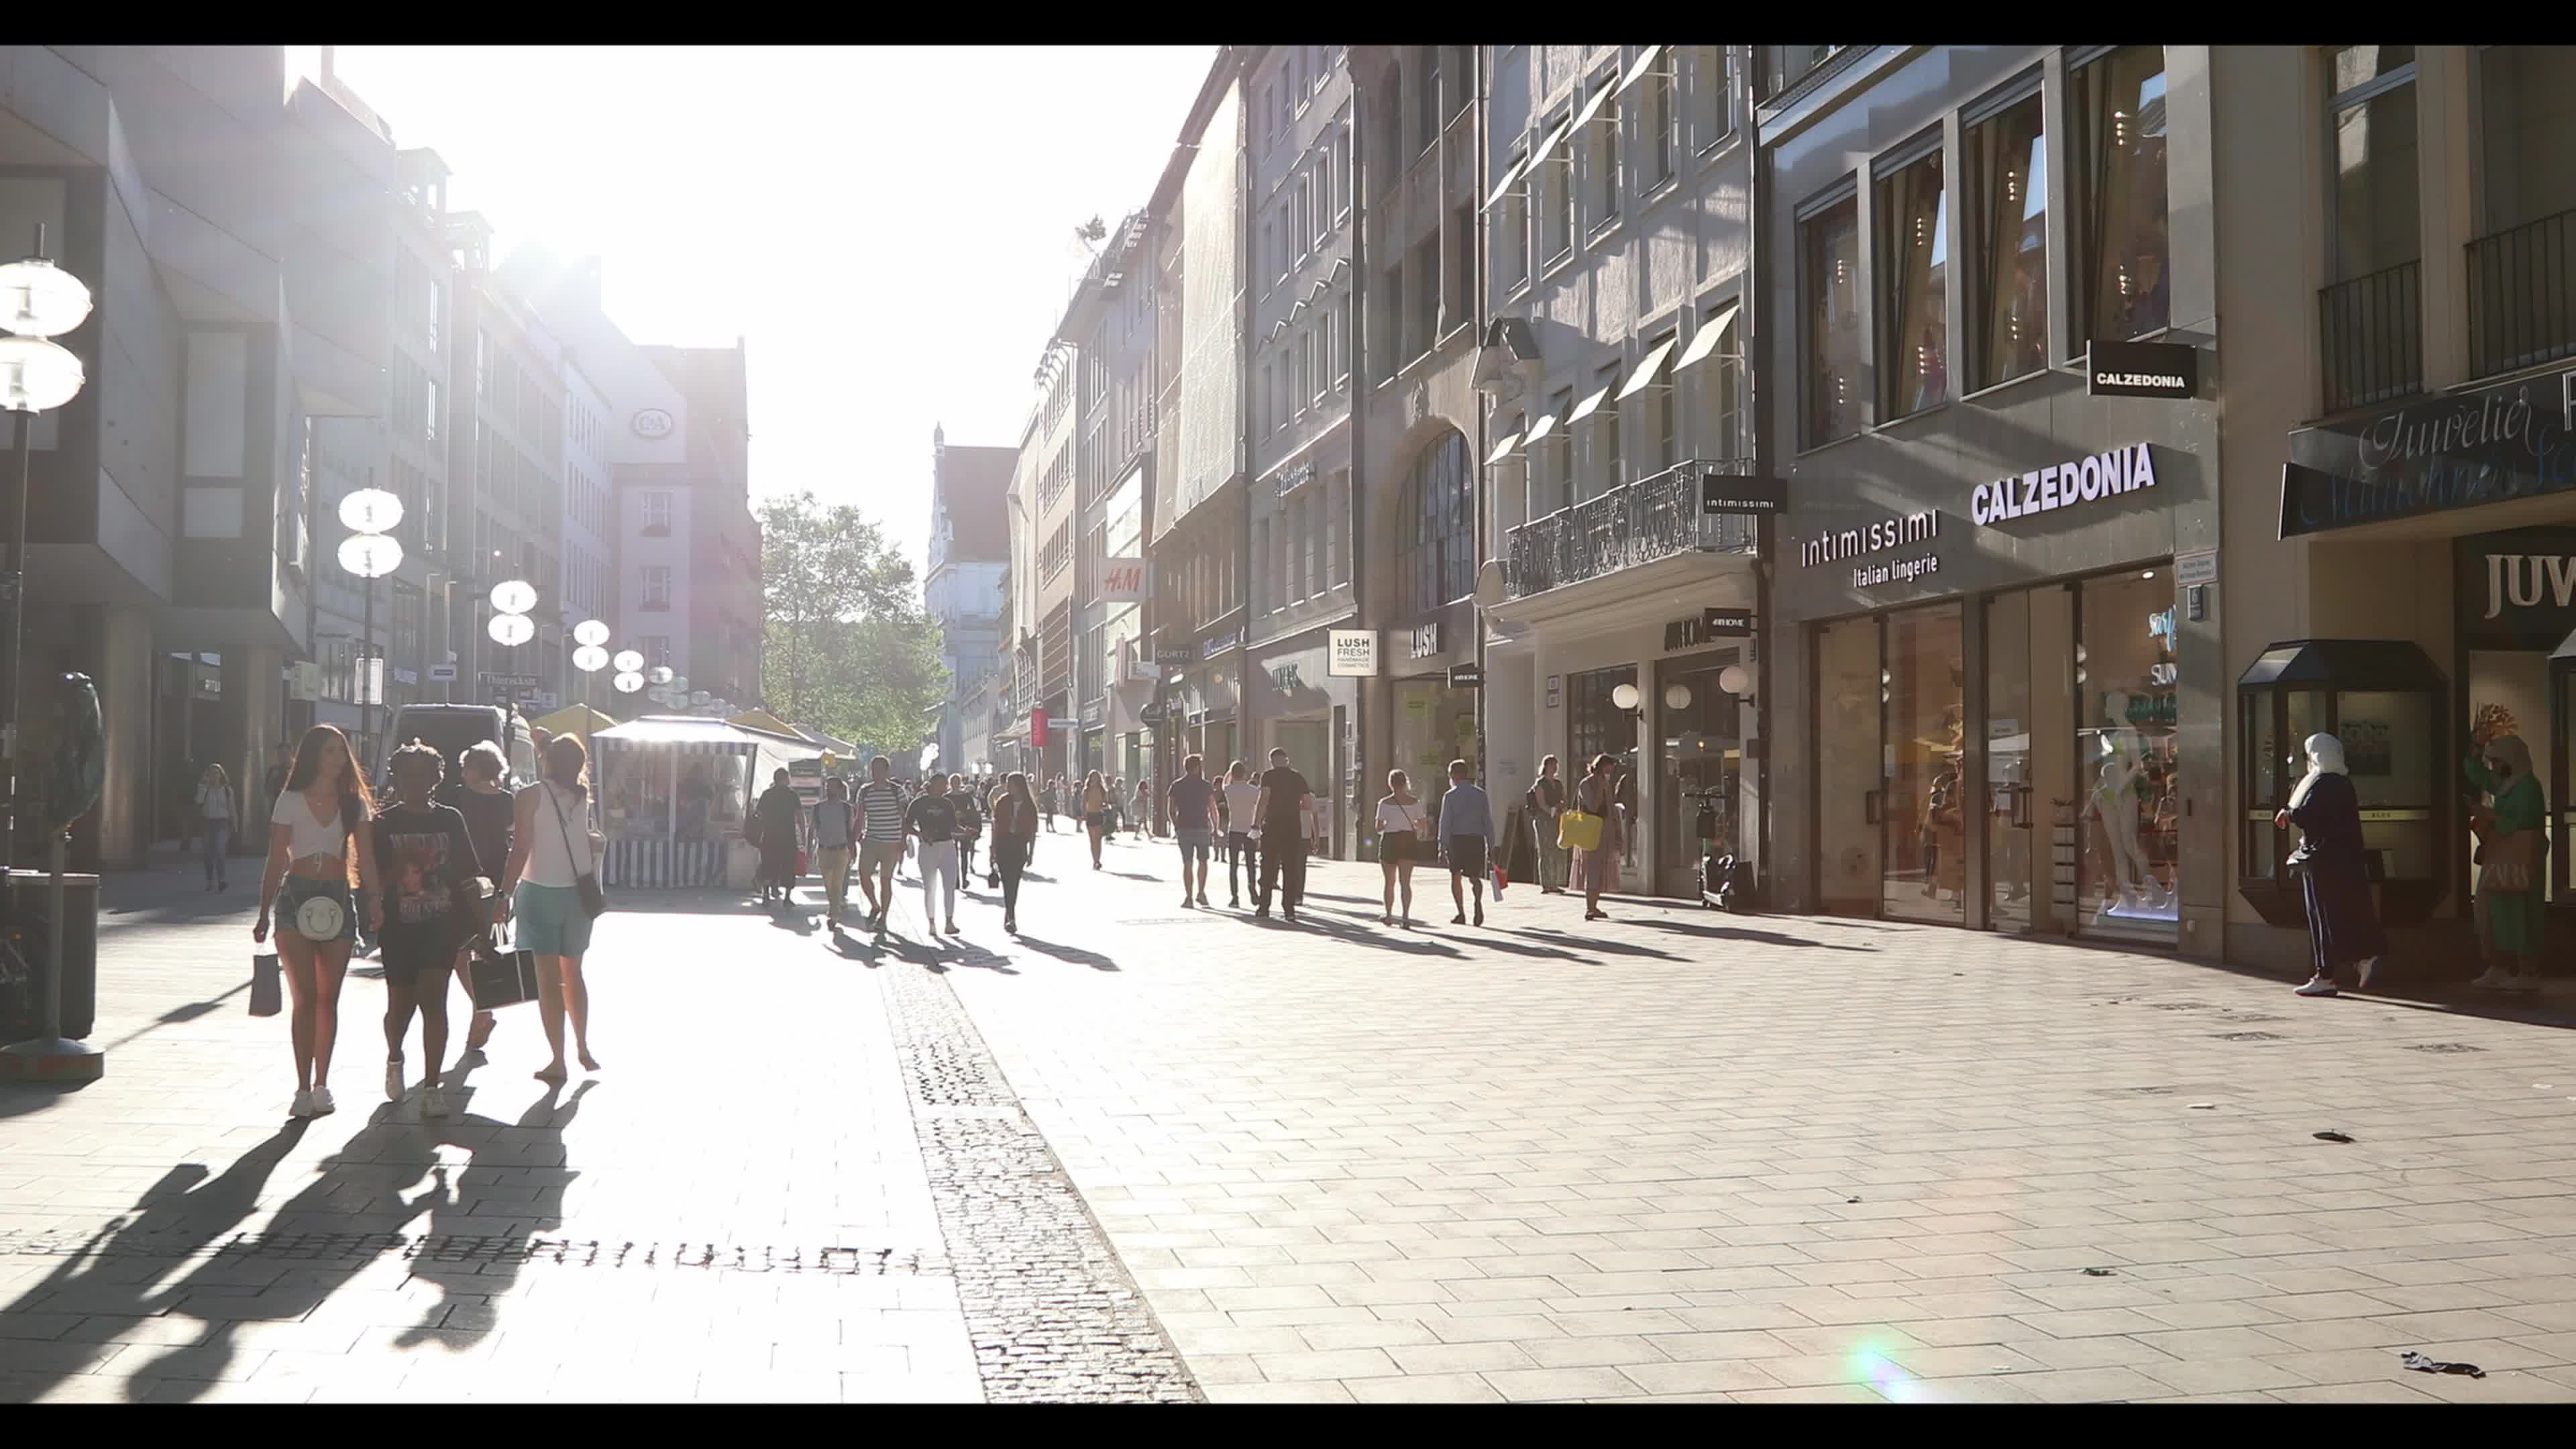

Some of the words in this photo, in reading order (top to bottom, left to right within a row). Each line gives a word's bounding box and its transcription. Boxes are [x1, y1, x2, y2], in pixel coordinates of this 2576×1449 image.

[2096, 372, 2186, 388] CALZEDONIA
[1972, 442, 2155, 526] CALZEDONIA
[1707, 498, 1774, 508] intimissimi
[1802, 508, 1937, 568] intimissimi
[1854, 565, 1889, 588] Italian
[1892, 552, 1937, 583] lingerie
[1337, 638, 1370, 647] LUSH
[1337, 647, 1370, 657] FRESH
[1411, 623, 1437, 659] LUSH
